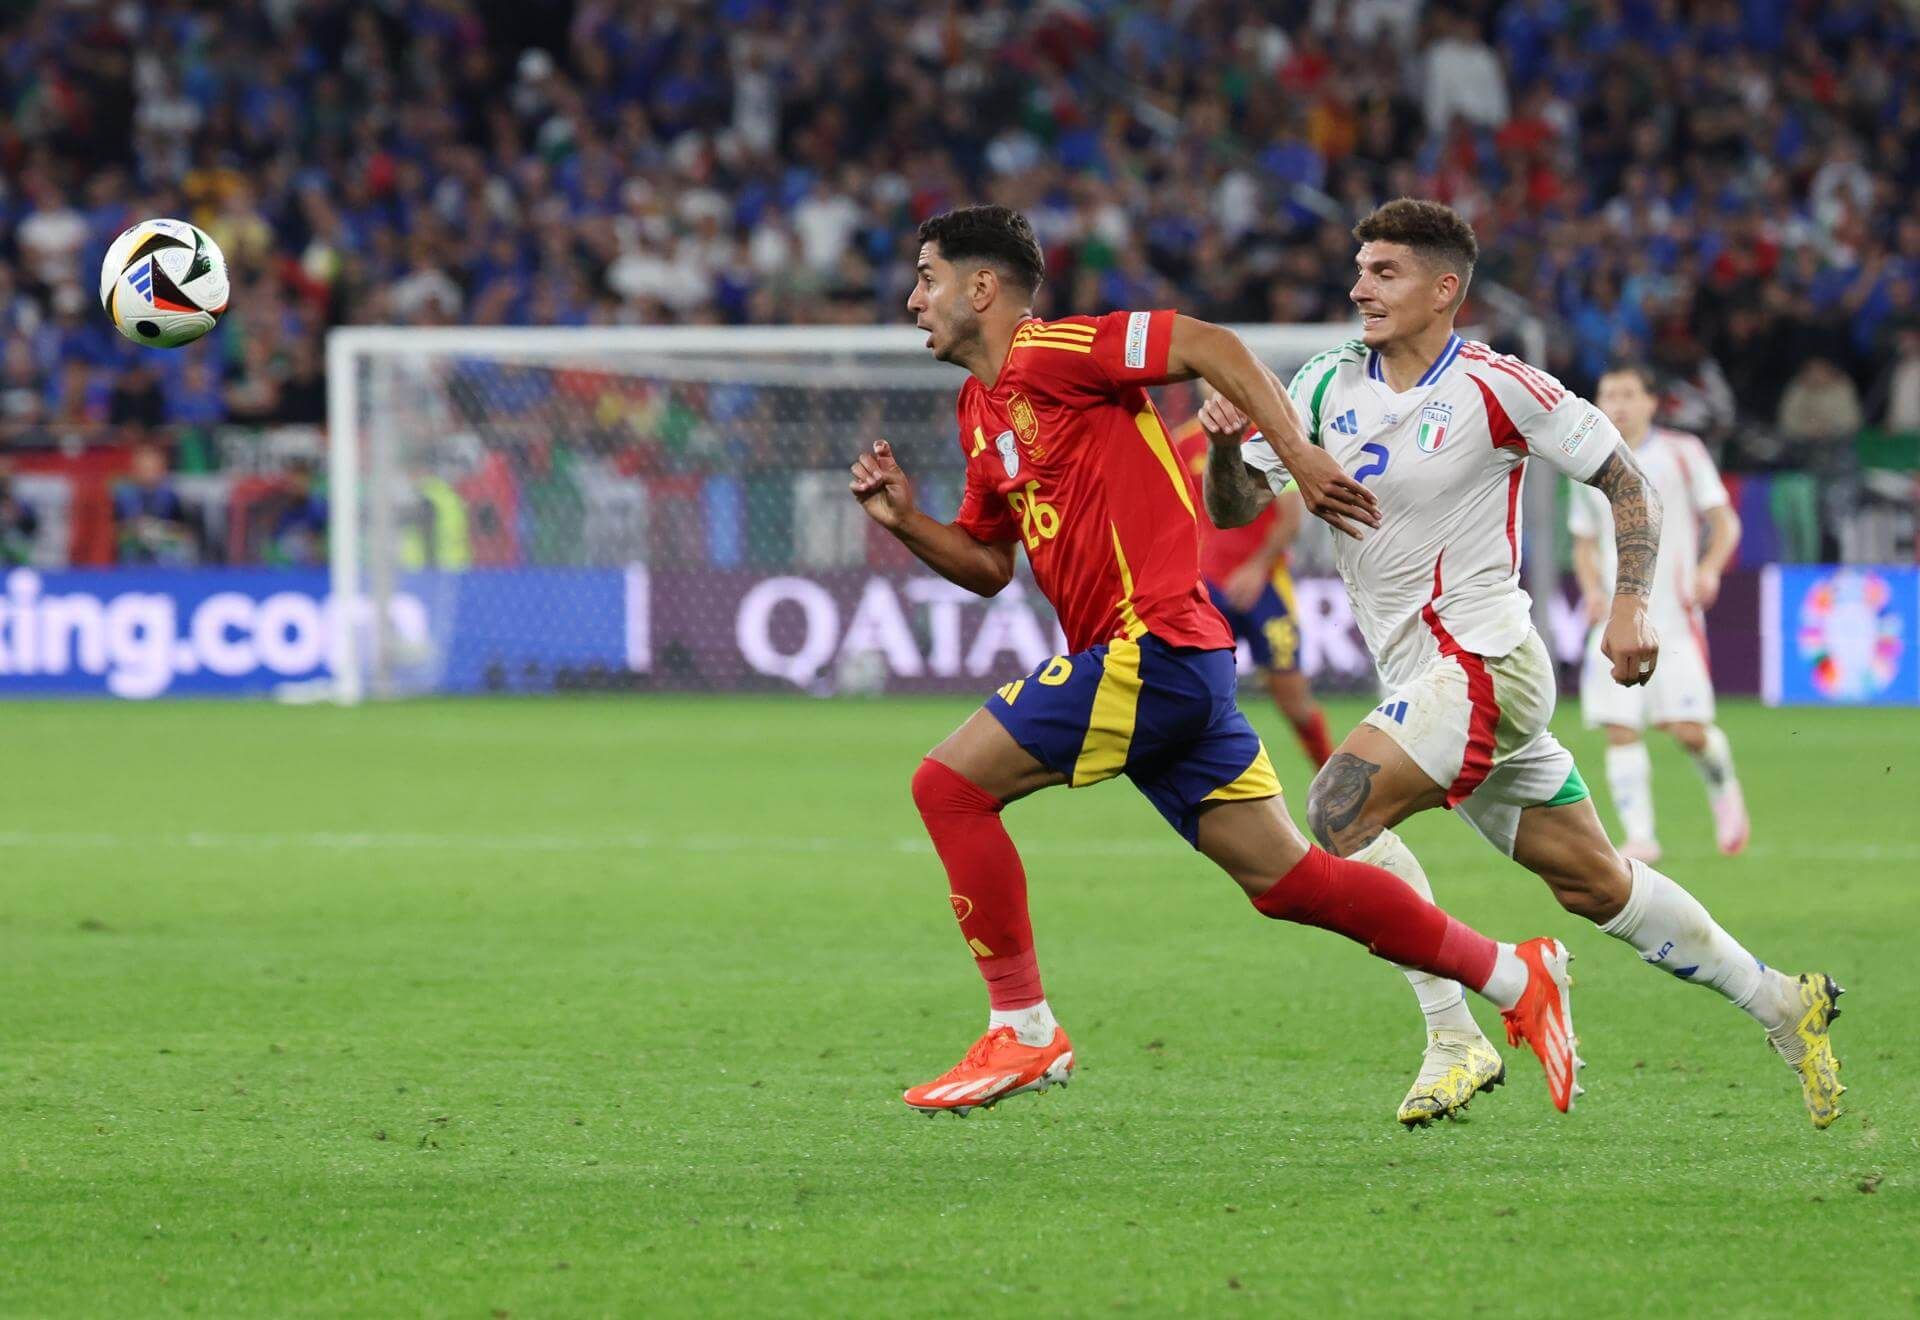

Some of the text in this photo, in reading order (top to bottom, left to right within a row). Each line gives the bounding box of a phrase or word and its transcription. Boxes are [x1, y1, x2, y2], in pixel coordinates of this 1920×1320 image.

[1424, 410, 1448, 422] ITALIA
[1354, 442, 1390, 483] 2
[1007, 479, 1060, 550] 26
[0, 566, 428, 700] ing.co
[734, 575, 1069, 691] QATA
